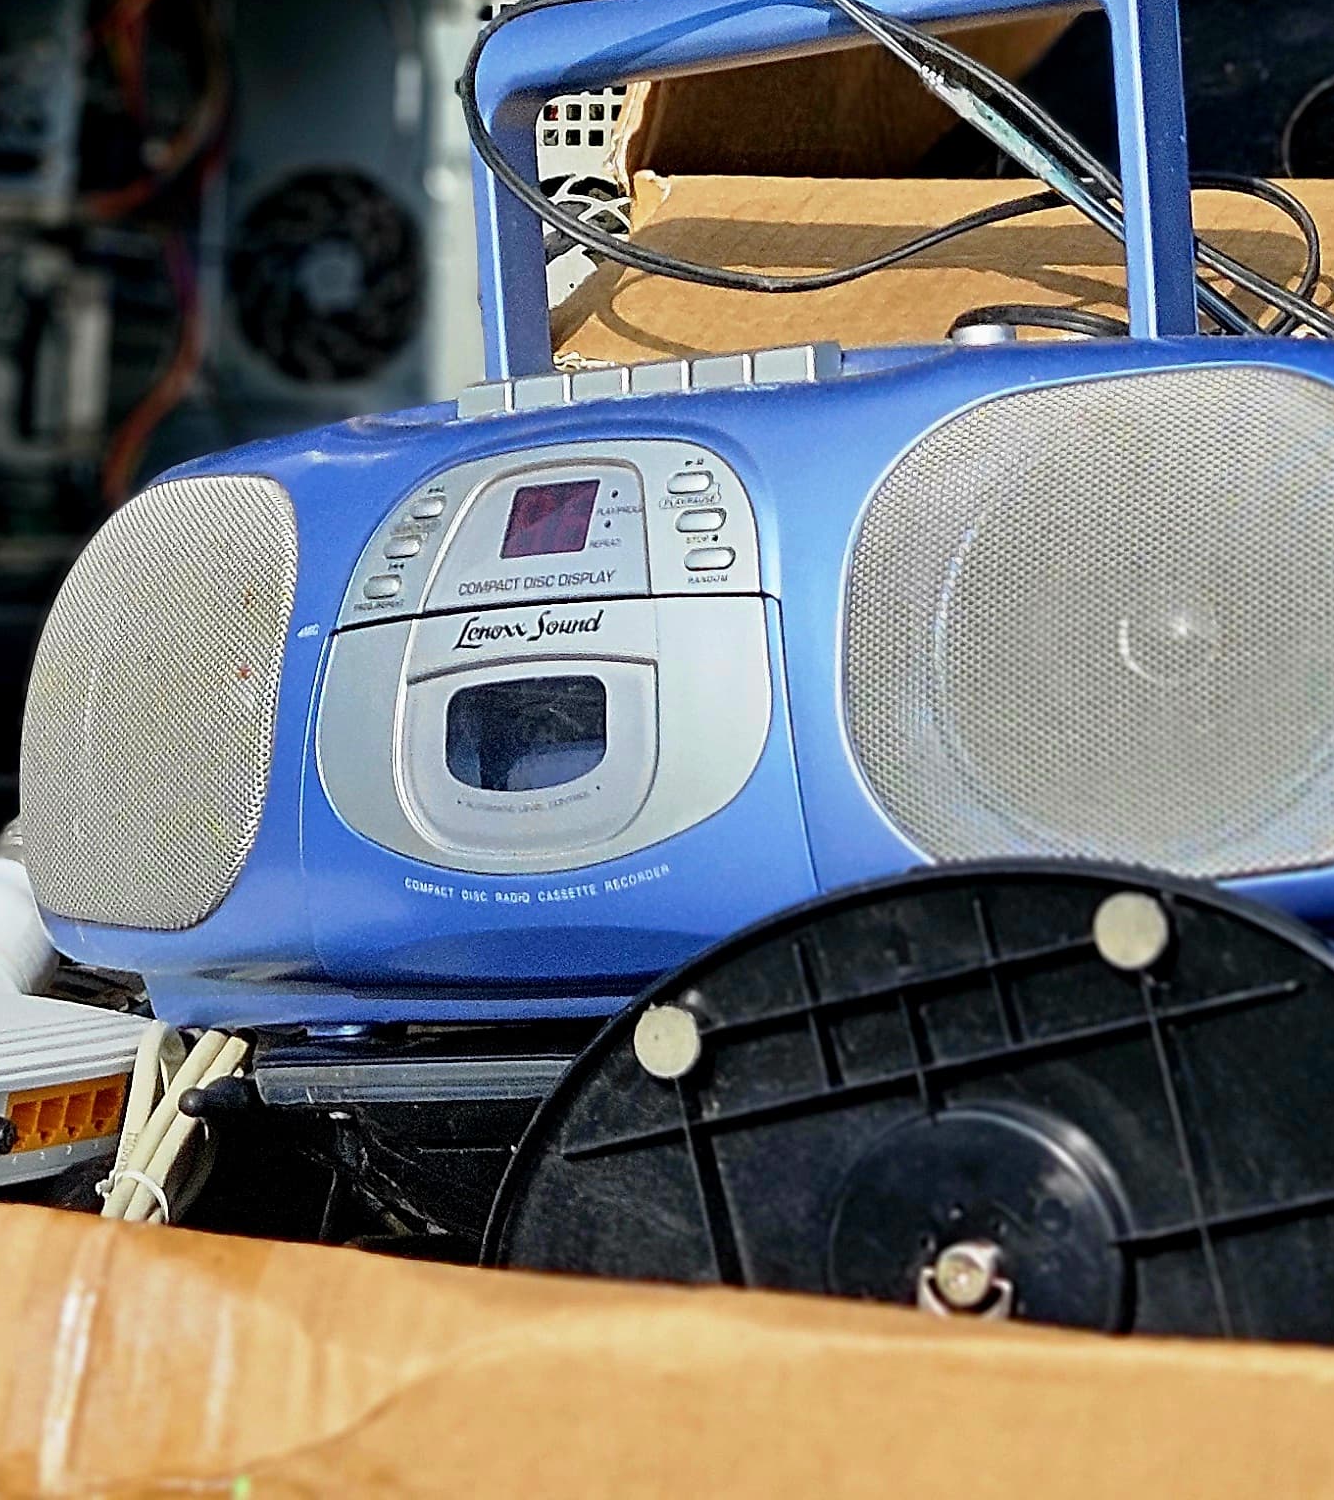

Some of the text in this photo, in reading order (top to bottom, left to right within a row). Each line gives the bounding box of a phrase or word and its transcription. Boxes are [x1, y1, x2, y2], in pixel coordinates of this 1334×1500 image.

[458, 570, 616, 596] COMPACT DISC DISPLAY
[527, 609, 604, 642] Sound
[404, 863, 670, 904] COMPACT DISC RADIO CASSETTE RECORDER
